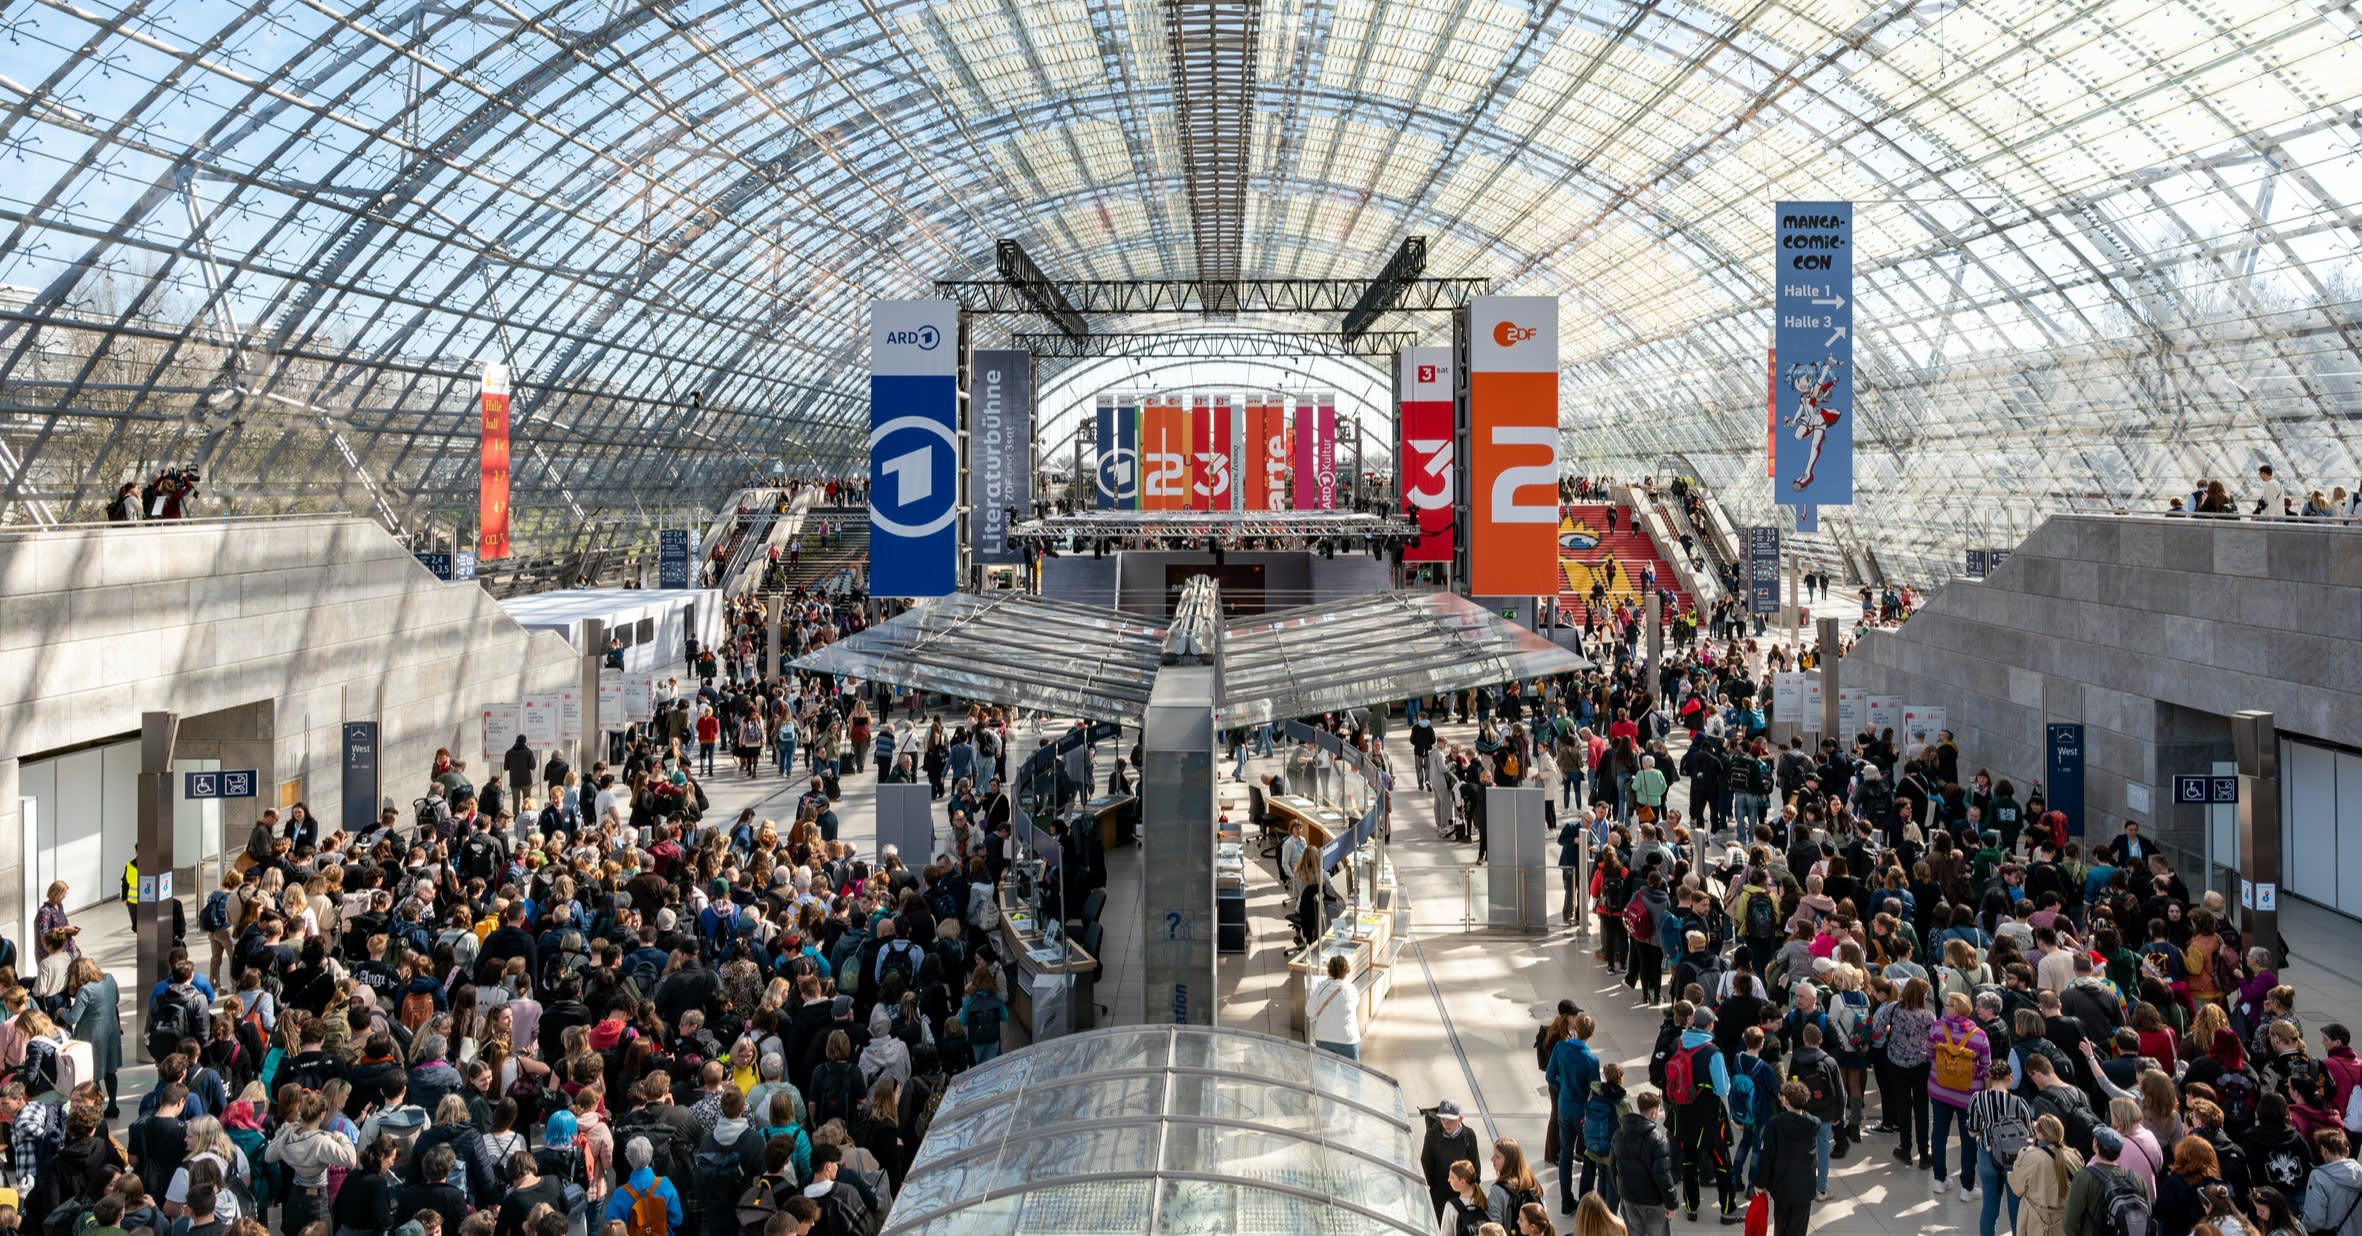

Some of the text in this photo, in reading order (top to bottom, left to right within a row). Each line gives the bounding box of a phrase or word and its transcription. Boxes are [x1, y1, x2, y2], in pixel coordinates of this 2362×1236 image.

[1783, 215, 1845, 229] MANGA-
[1793, 254, 1832, 270] CON
[1784, 284, 1831, 297] Halle 1
[1784, 315, 1832, 328] Halle 3
[887, 331, 918, 345] ARD
[486, 400, 502, 412] Halle
[486, 417, 498, 430] hall
[1005, 424, 1015, 452] 3sat
[982, 369, 1001, 555] Literaturbühne
[1322, 438, 1331, 470] Kultur
[881, 444, 932, 508] 1
[1145, 452, 1184, 496] 2
[1193, 453, 1229, 496] 3
[1267, 435, 1286, 511] arte
[1406, 439, 1453, 510] 3
[1491, 426, 1559, 523] 2
[1005, 478, 1014, 501] ZDF
[1322, 486, 1331, 509] ARD
[431, 555, 443, 565] 2,4
[431, 565, 450, 574] 1,3,5
[351, 752, 357, 761] 2
[352, 744, 370, 753] West
[2057, 746, 2078, 756] West
